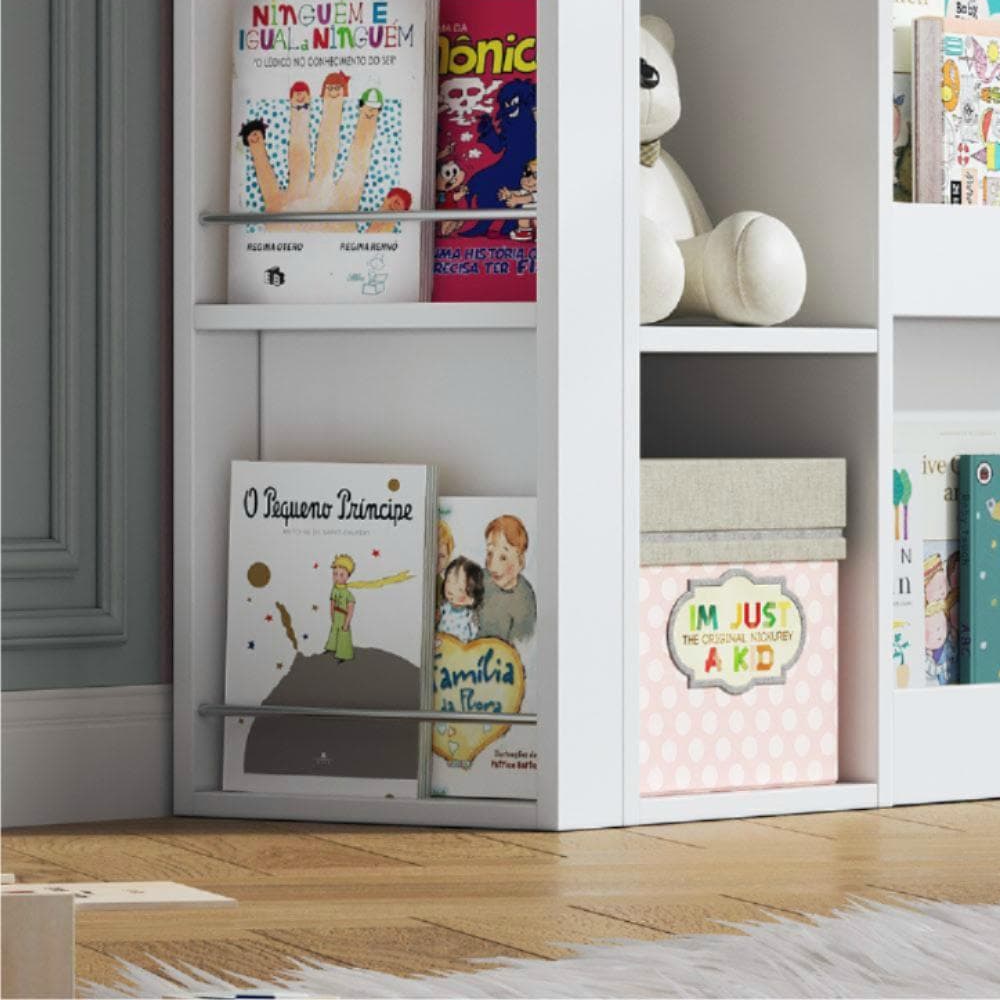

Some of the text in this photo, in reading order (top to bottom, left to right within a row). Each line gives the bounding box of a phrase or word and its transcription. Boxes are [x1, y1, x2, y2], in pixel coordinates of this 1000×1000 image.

[238, 26, 300, 51] IGUAL
[438, 33, 538, 76] ônic
[433, 261, 478, 274] RECISA
[244, 486, 259, 518] O
[263, 486, 333, 527] Pequeno
[688, 600, 793, 632] IM JUST
[682, 633, 699, 646] THE
[704, 646, 722, 674] A
